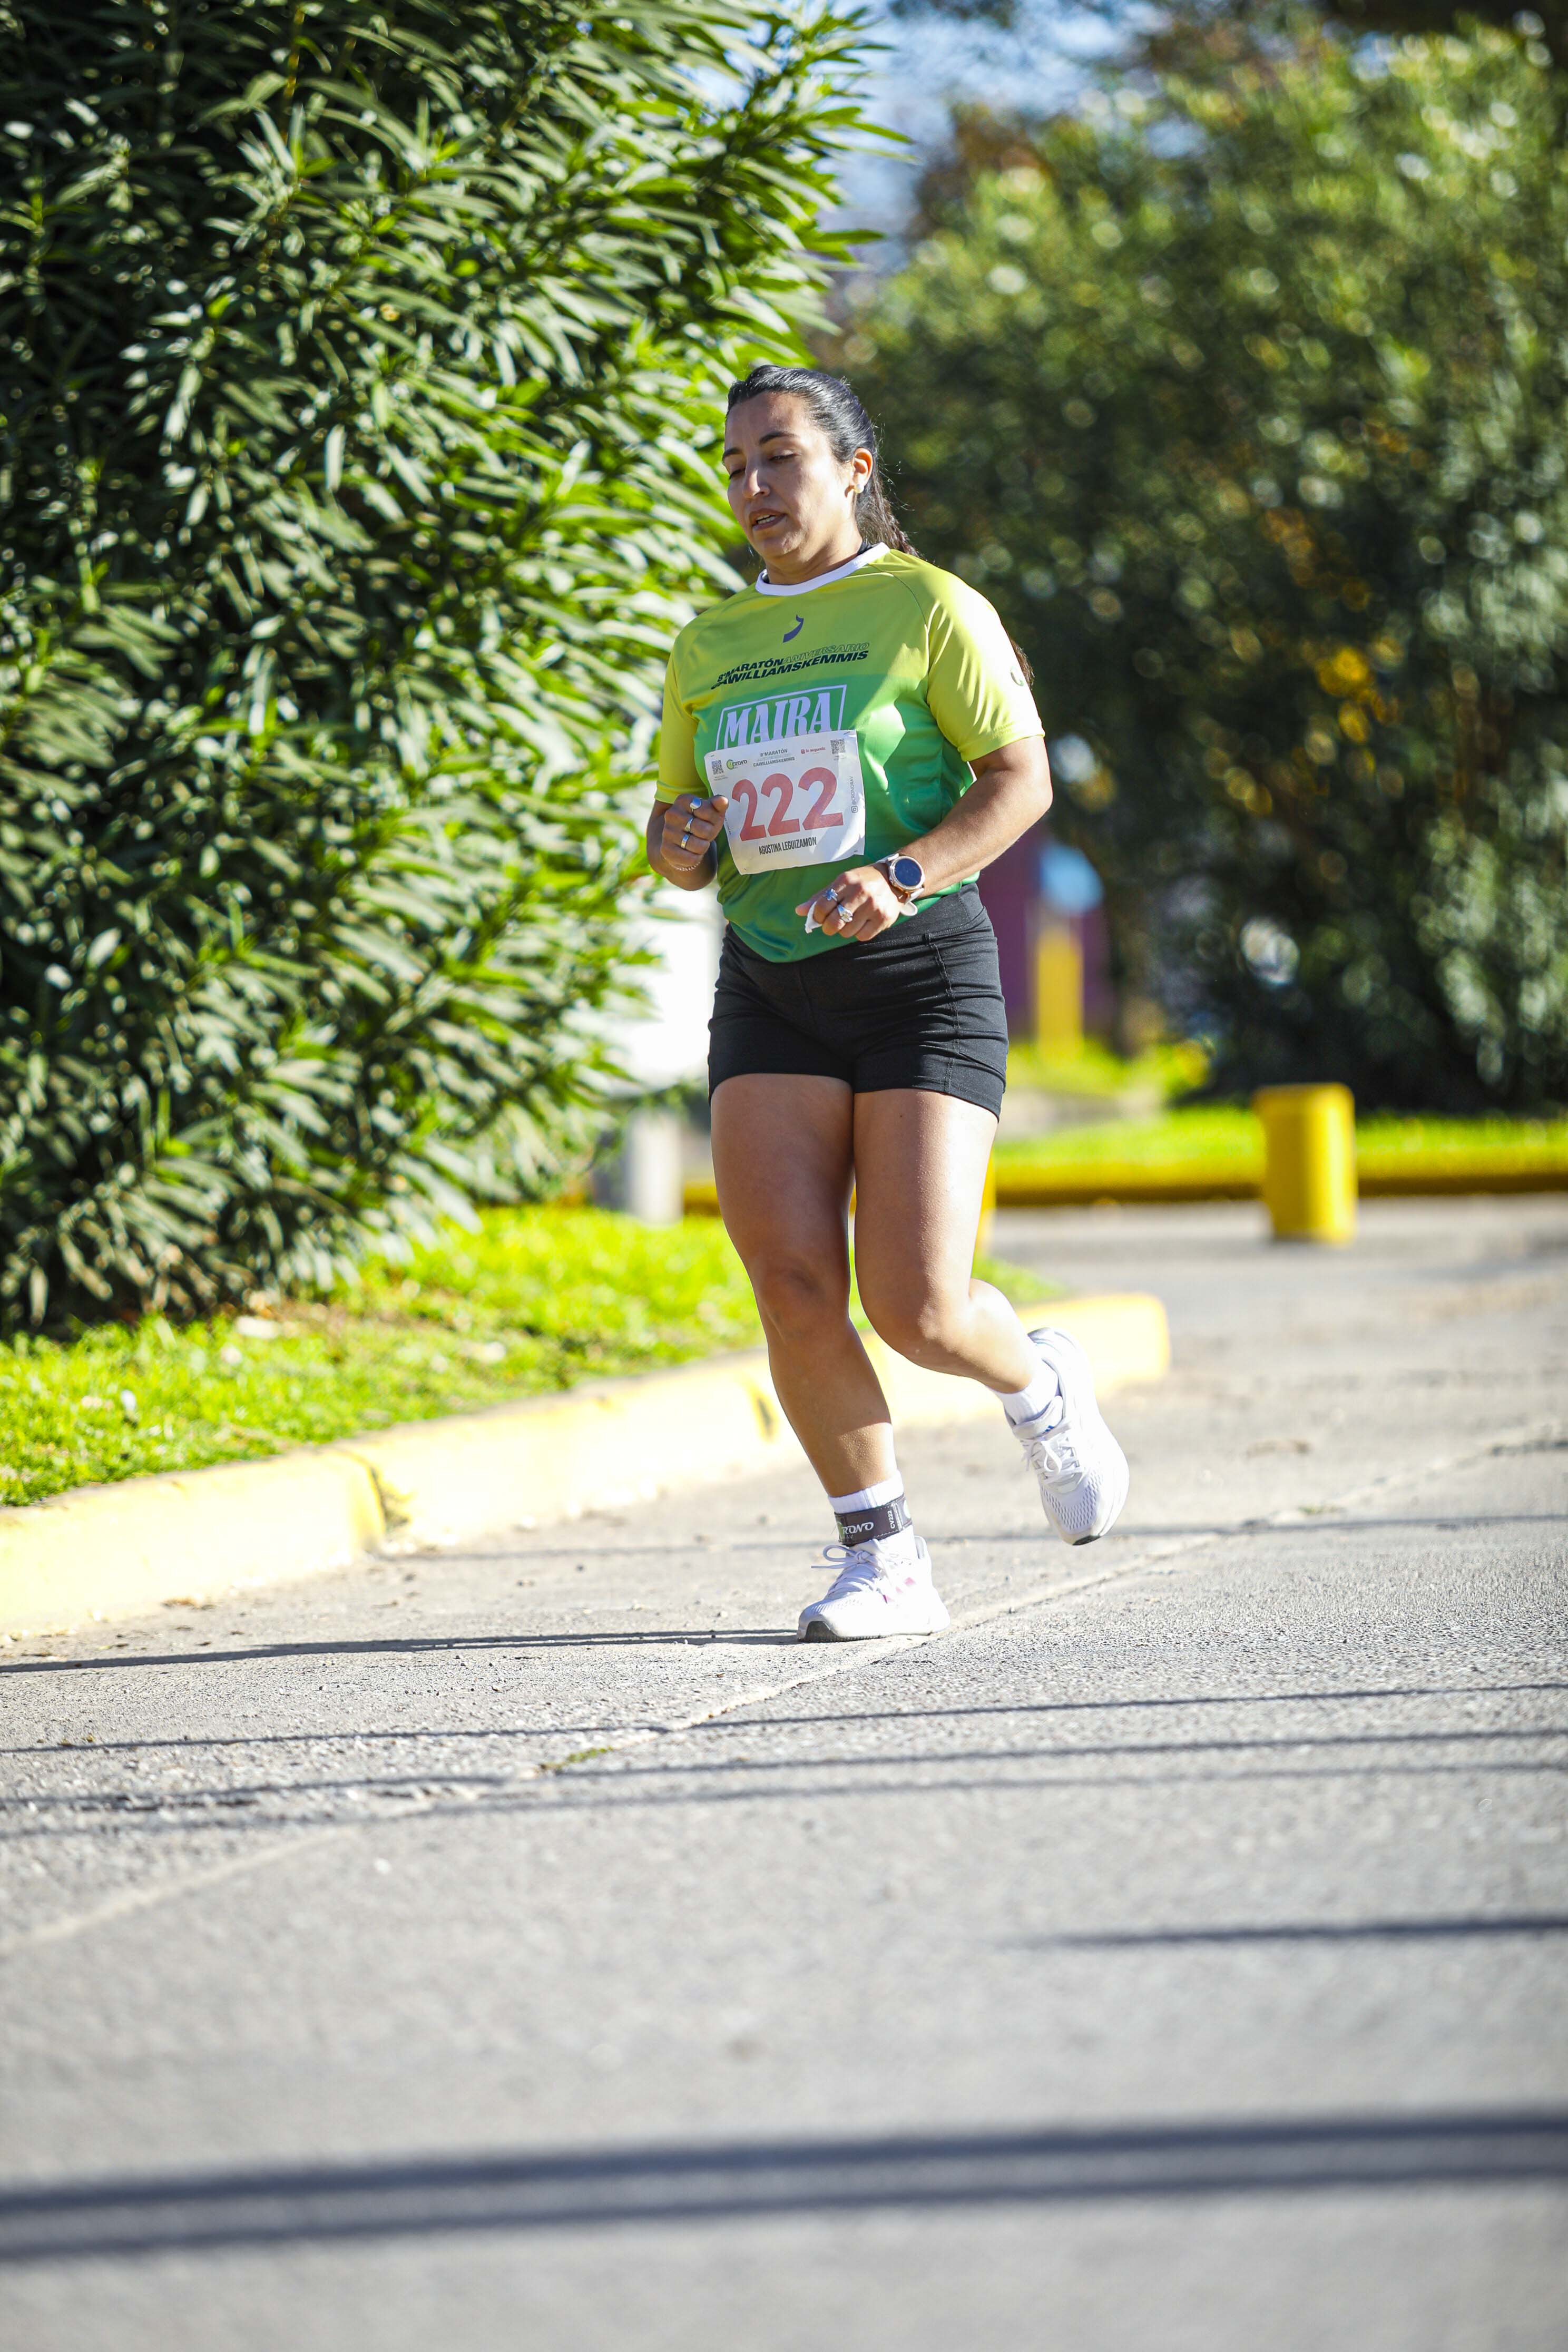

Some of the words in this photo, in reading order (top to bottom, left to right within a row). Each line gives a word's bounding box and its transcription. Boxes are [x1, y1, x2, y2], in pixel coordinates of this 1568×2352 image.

[724, 692, 832, 749] MAIRA
[732, 767, 844, 841] 222
[759, 842, 782, 855] AGUSTINA
[782, 836, 817, 851] LEGUIZAMON
